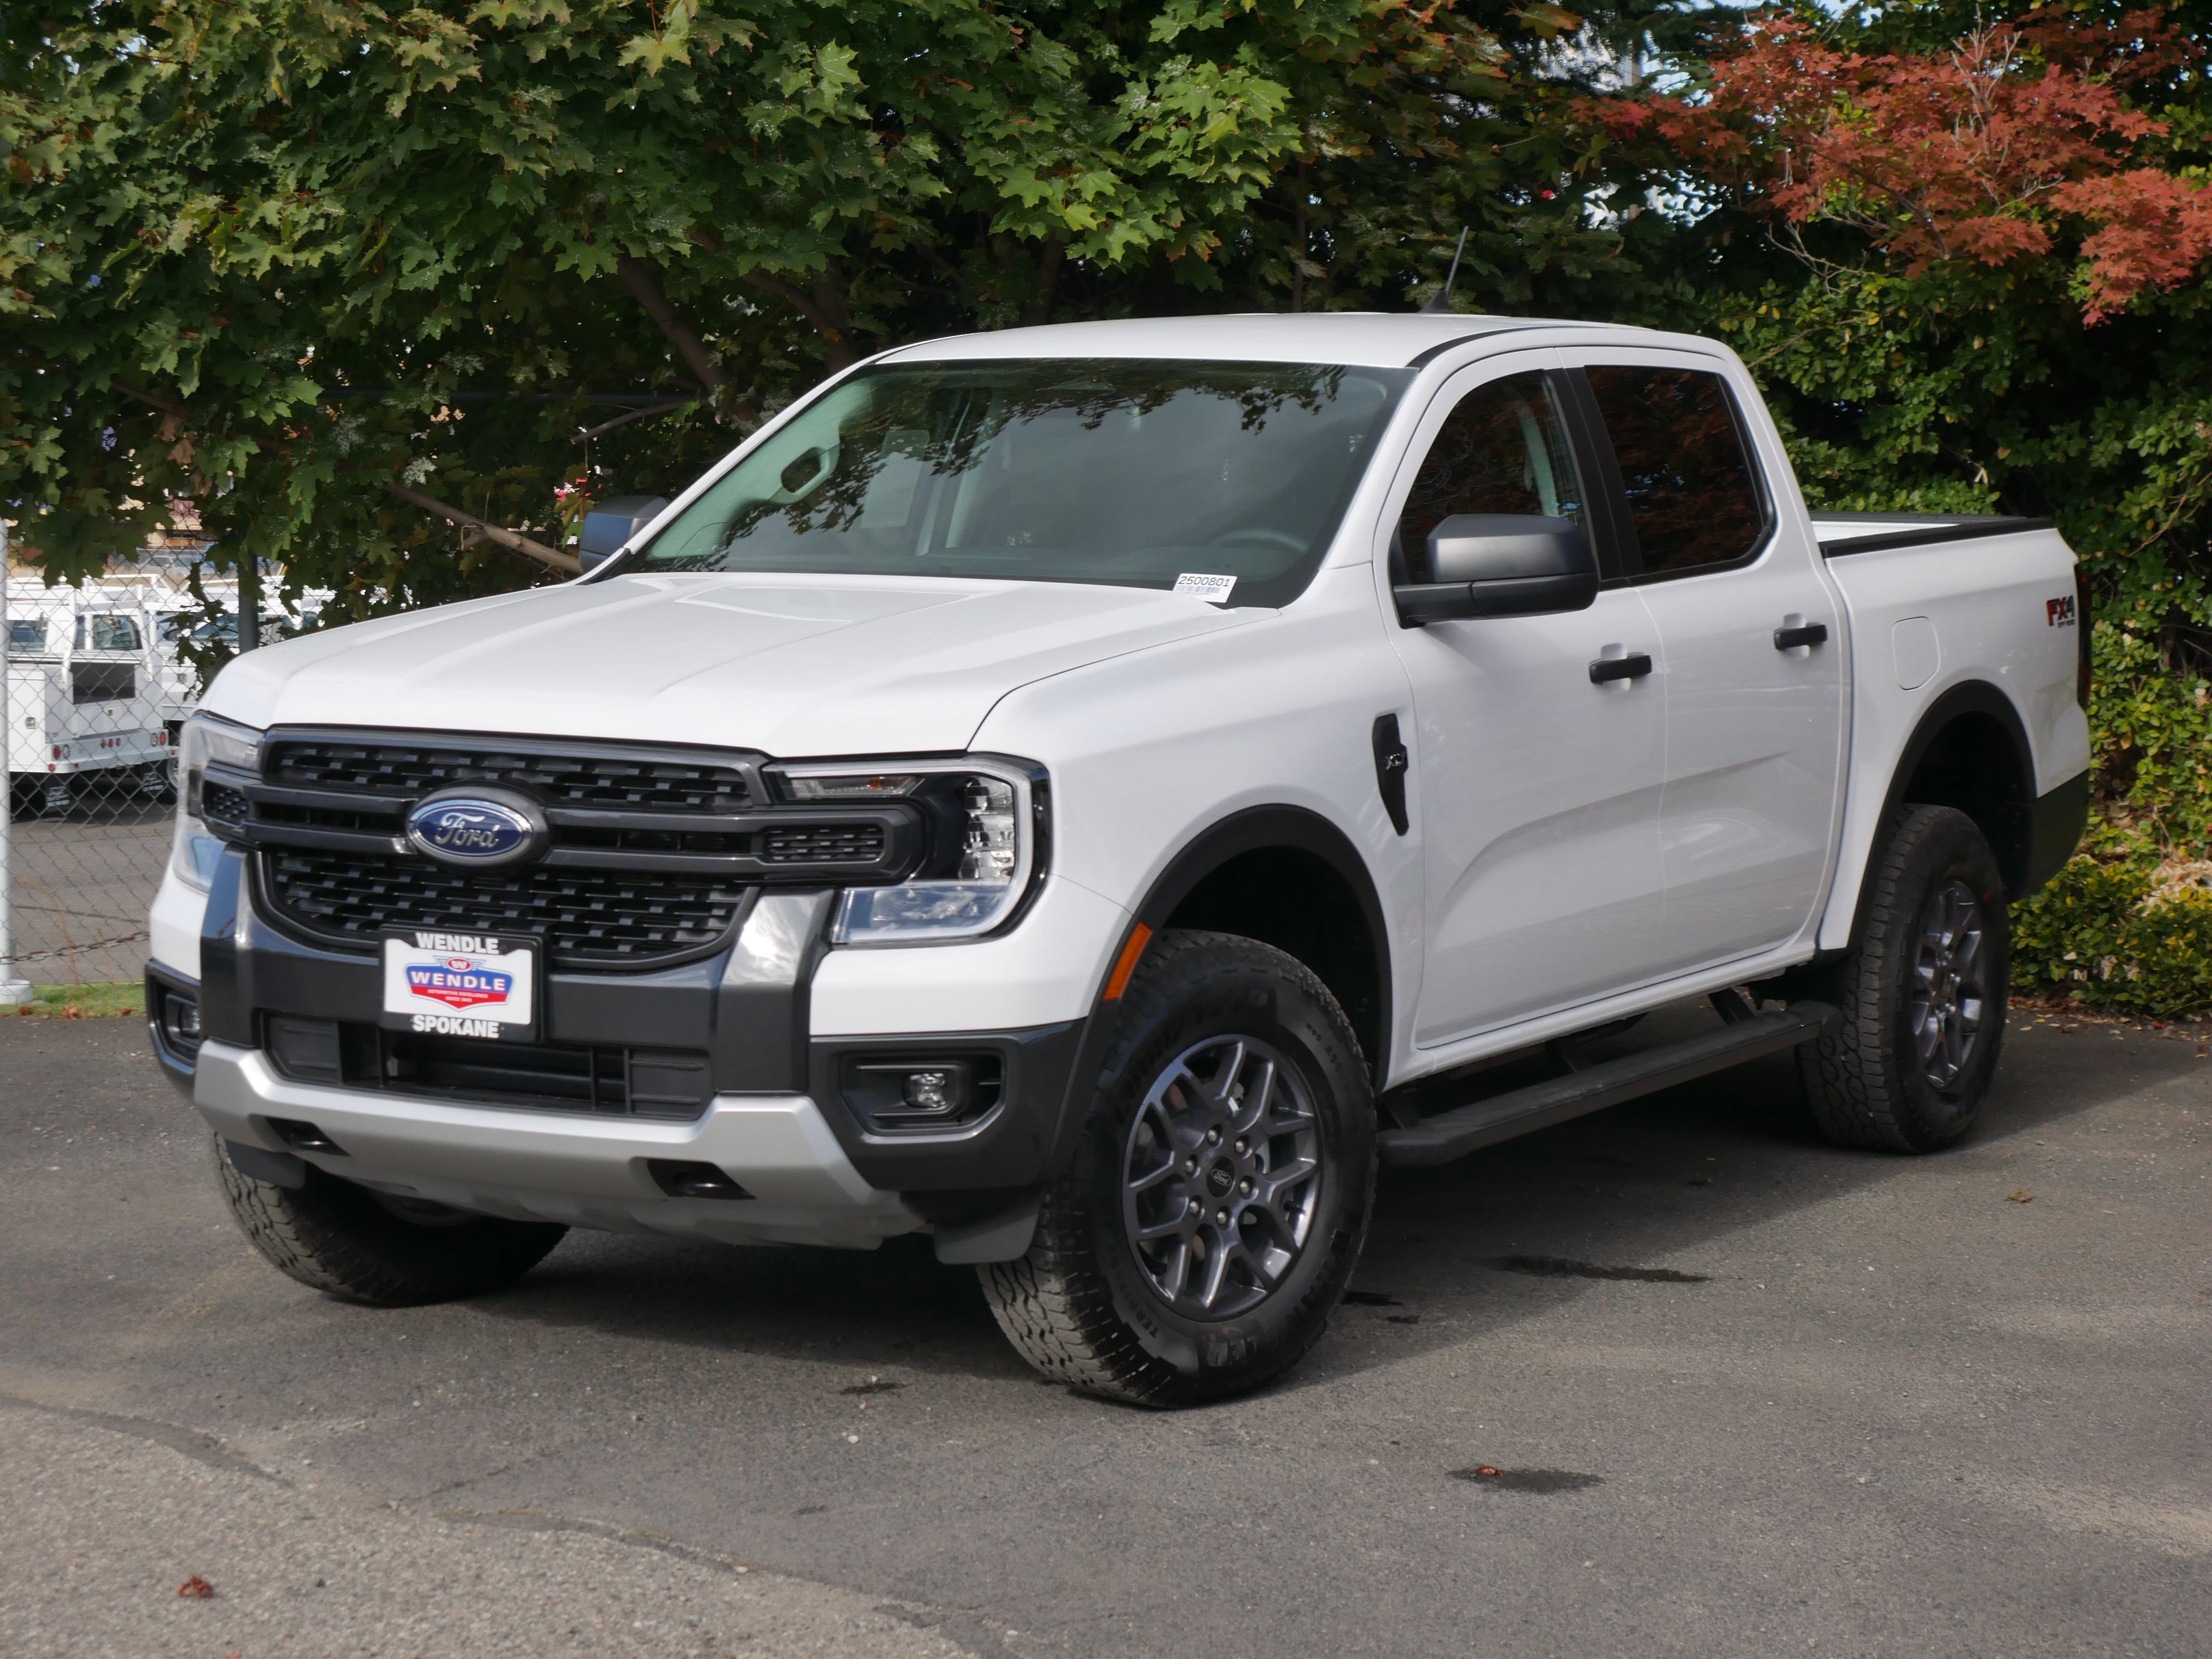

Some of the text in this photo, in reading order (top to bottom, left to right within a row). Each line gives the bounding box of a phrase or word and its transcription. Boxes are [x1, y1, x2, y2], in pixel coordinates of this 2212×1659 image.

[1178, 576, 1231, 587] 2500801
[2046, 595, 2074, 627] FX4
[434, 812, 501, 849] Ford
[415, 932, 500, 955] WENDLE
[411, 970, 506, 992] WENDLE
[412, 1014, 500, 1039] SPOKANE
[1214, 1170, 1229, 1185] Ford
